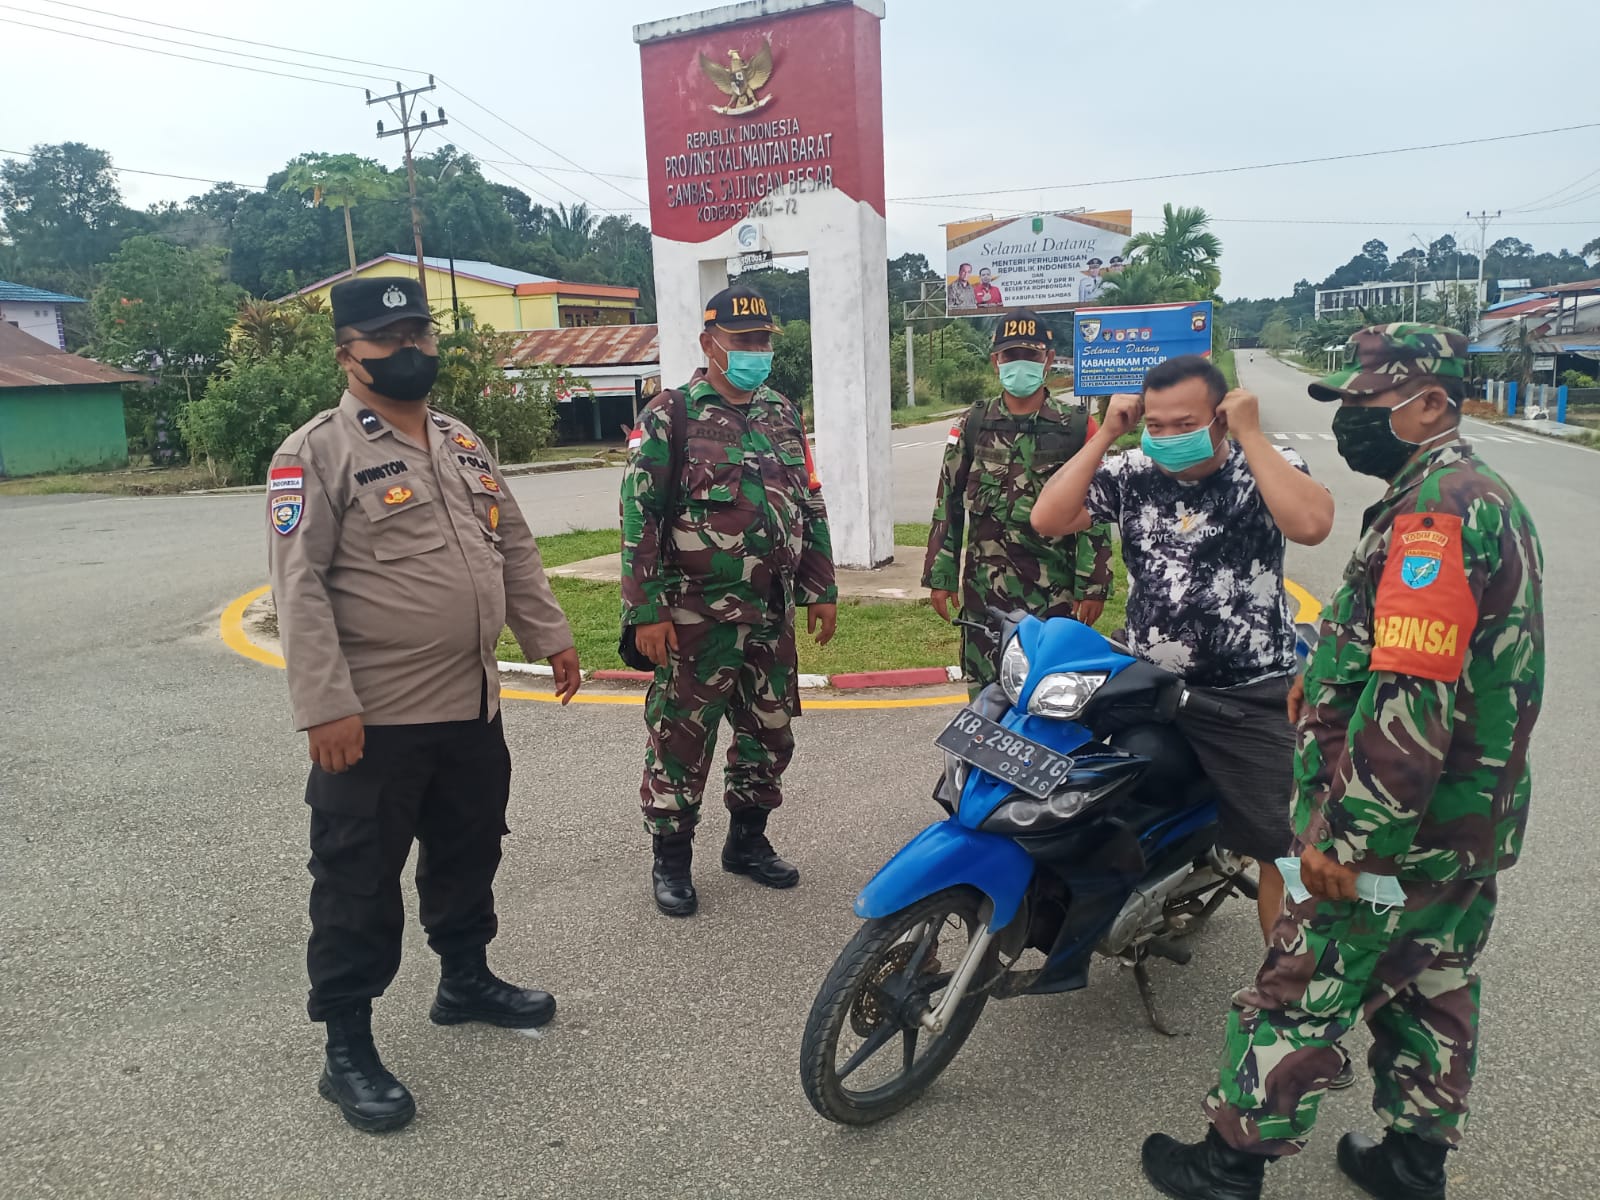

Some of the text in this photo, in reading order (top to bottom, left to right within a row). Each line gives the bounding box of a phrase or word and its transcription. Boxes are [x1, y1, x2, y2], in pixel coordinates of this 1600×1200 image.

[687, 118, 800, 149] REPUBLIK INDONESIA
[665, 133, 832, 178] PROVINSI KALIMANTAN BARAT
[721, 172, 783, 200] SAJINGAN
[788, 165, 833, 195] BESAR
[698, 204, 743, 222] KODEPOS
[981, 238, 1096, 256] Selamat Datang
[991, 255, 1087, 267] MENTERI PERHUBUNGAN
[997, 262, 1080, 274] REPUBLIK INDONESIA
[732, 297, 768, 316] 1208
[1003, 320, 1036, 337] 1208
[1082, 344, 1160, 356] Selamat Datang
[1081, 358, 1140, 368] KABAHARKAM
[353, 460, 408, 486] WINSTON
[953, 711, 1068, 777] KB 2983 TG
